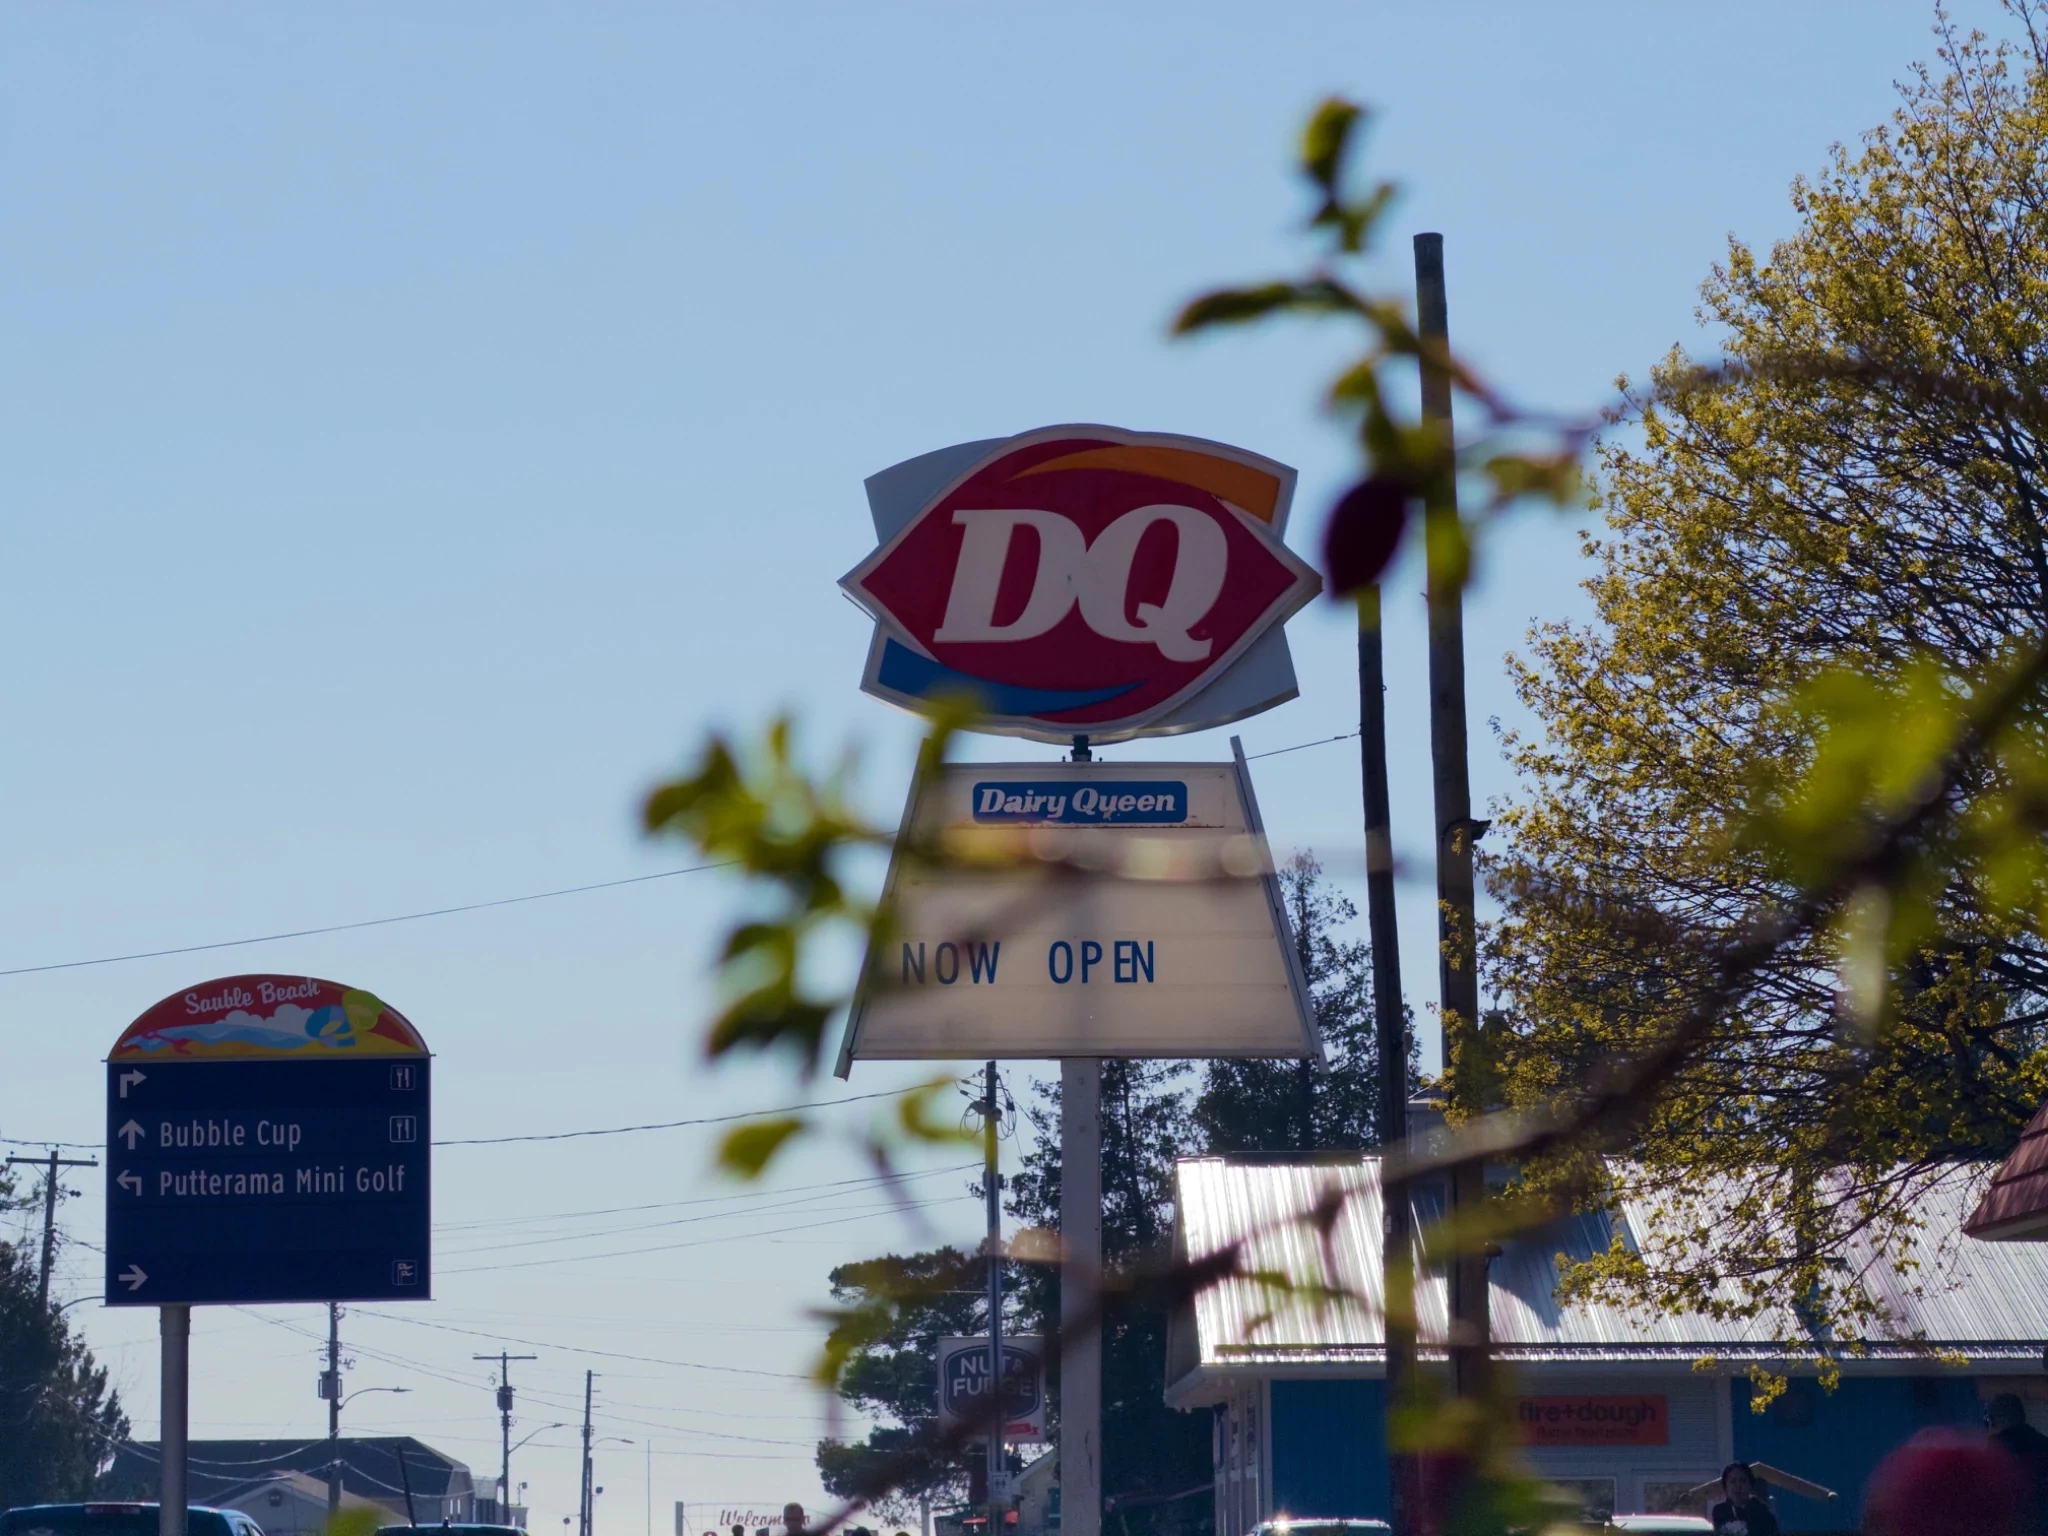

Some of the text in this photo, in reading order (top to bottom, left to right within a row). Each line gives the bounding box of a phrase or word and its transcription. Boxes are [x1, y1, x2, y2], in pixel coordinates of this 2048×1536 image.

[932, 503, 1229, 663] DQ
[977, 787, 1177, 819] Dairy Queen
[902, 940, 1155, 985] NOW OPEN
[184, 977, 321, 1015] Sauble Beach
[160, 1119, 302, 1151] Bubble Cup
[160, 1165, 405, 1197] Putterama Mini Golf
[719, 1508, 785, 1528] Welcom
